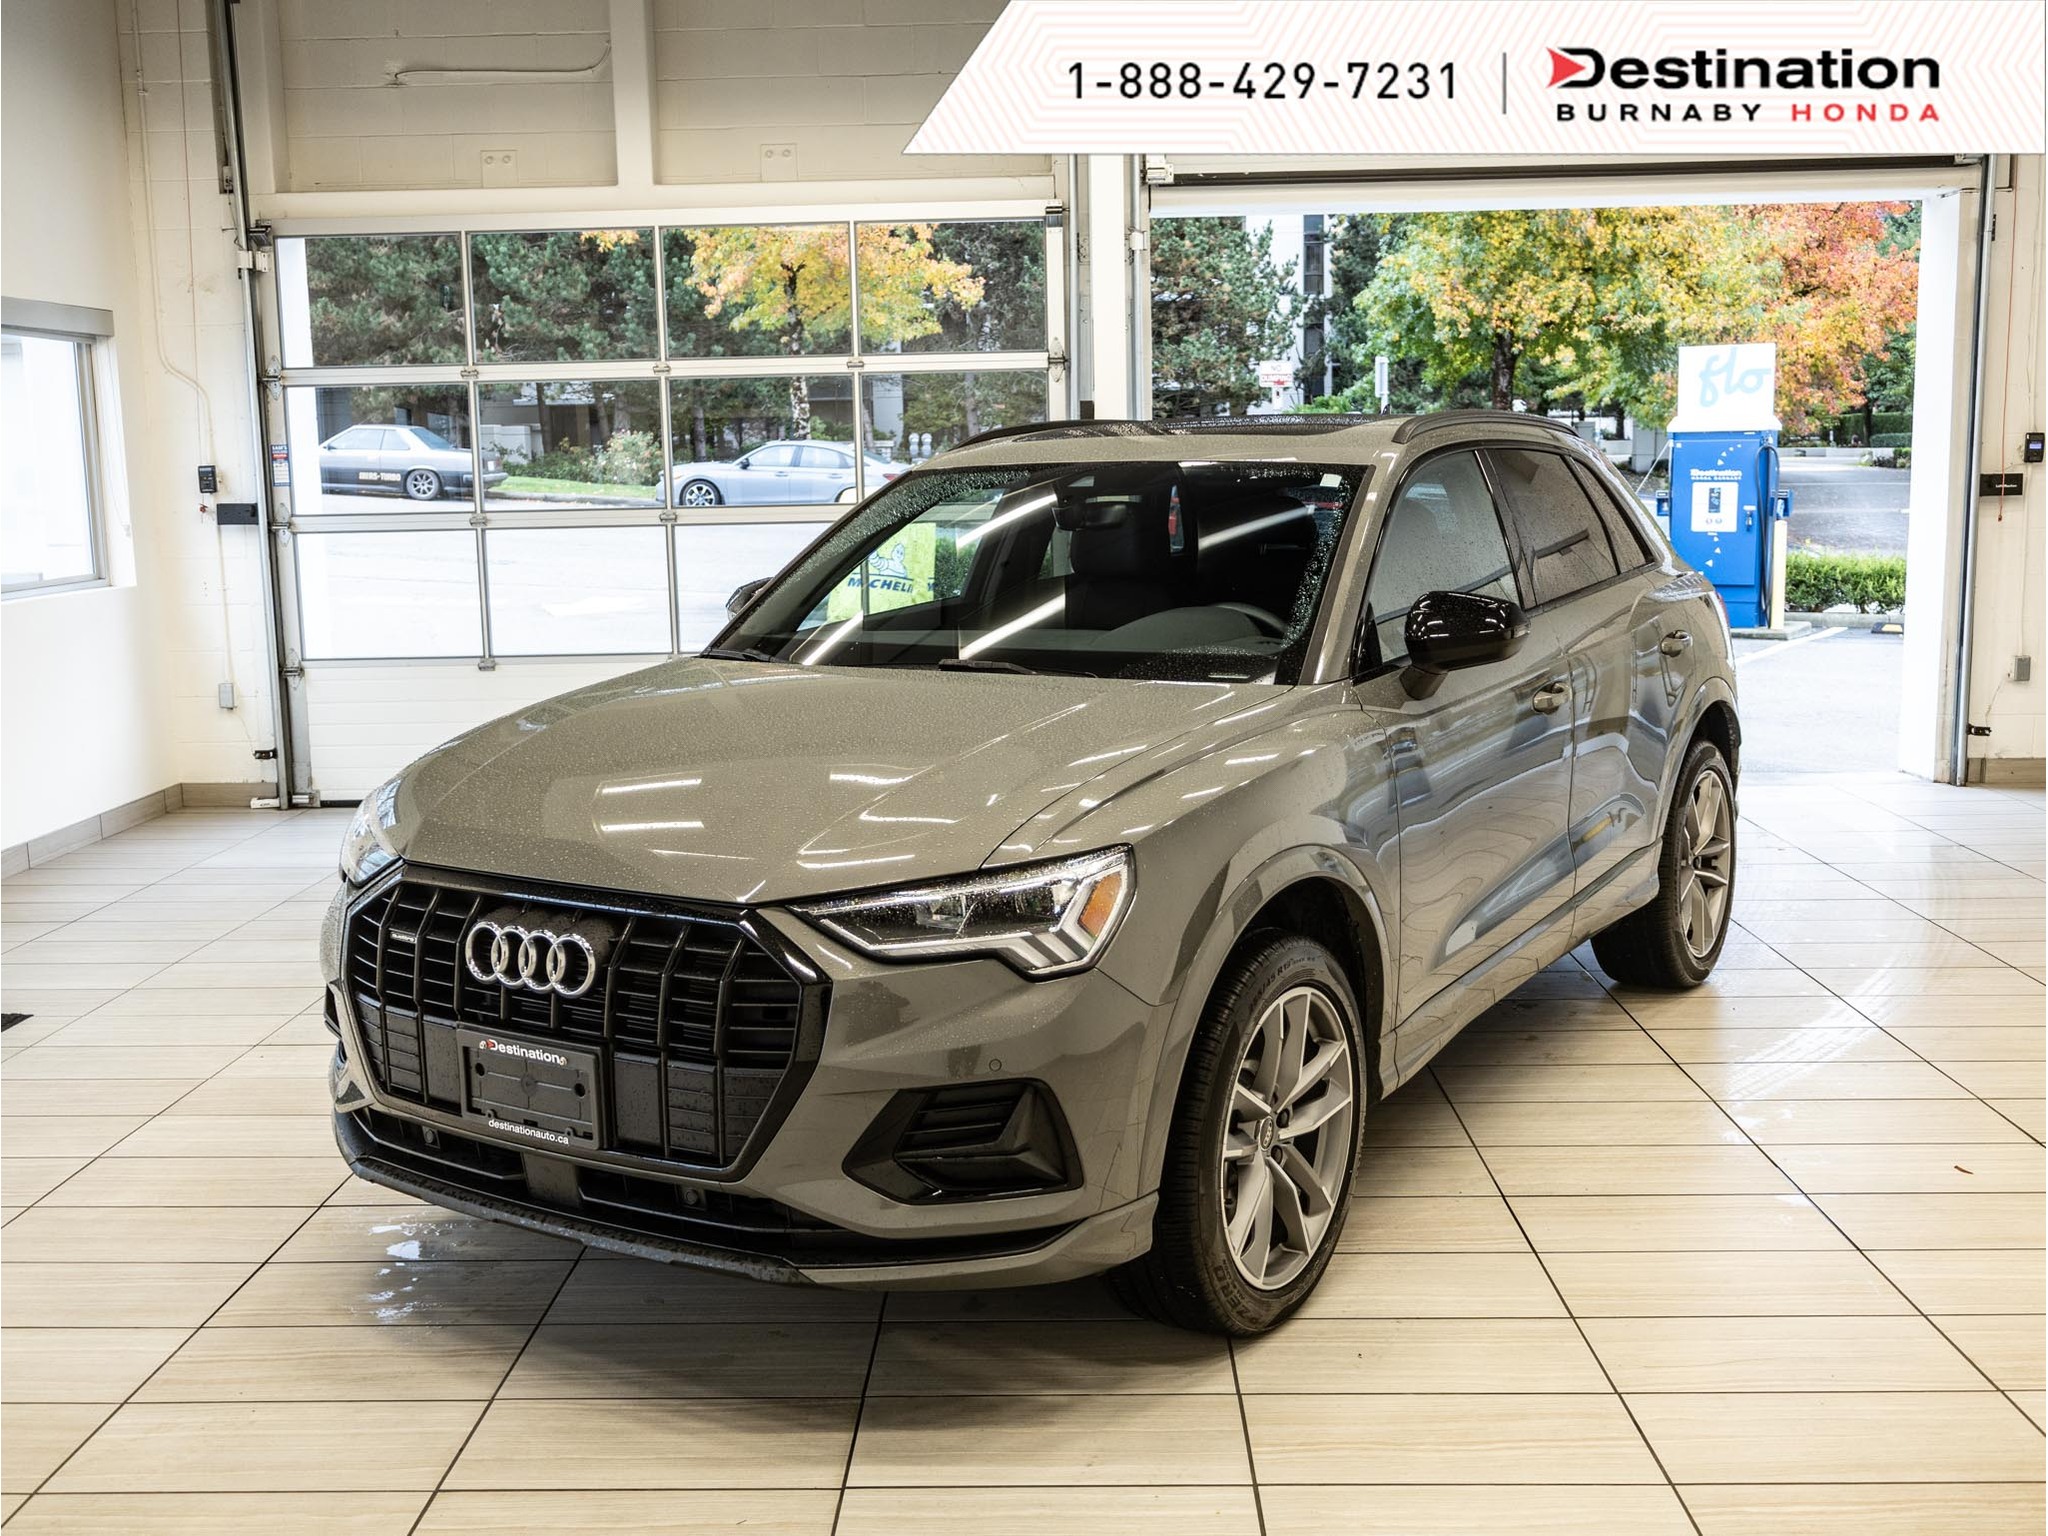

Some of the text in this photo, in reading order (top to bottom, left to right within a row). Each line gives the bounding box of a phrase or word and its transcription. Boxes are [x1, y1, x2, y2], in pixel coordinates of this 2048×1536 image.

[1699, 346, 1771, 407] flo
[486, 1038, 561, 1064] Destination
[488, 1119, 569, 1145] destinationauto.ca
